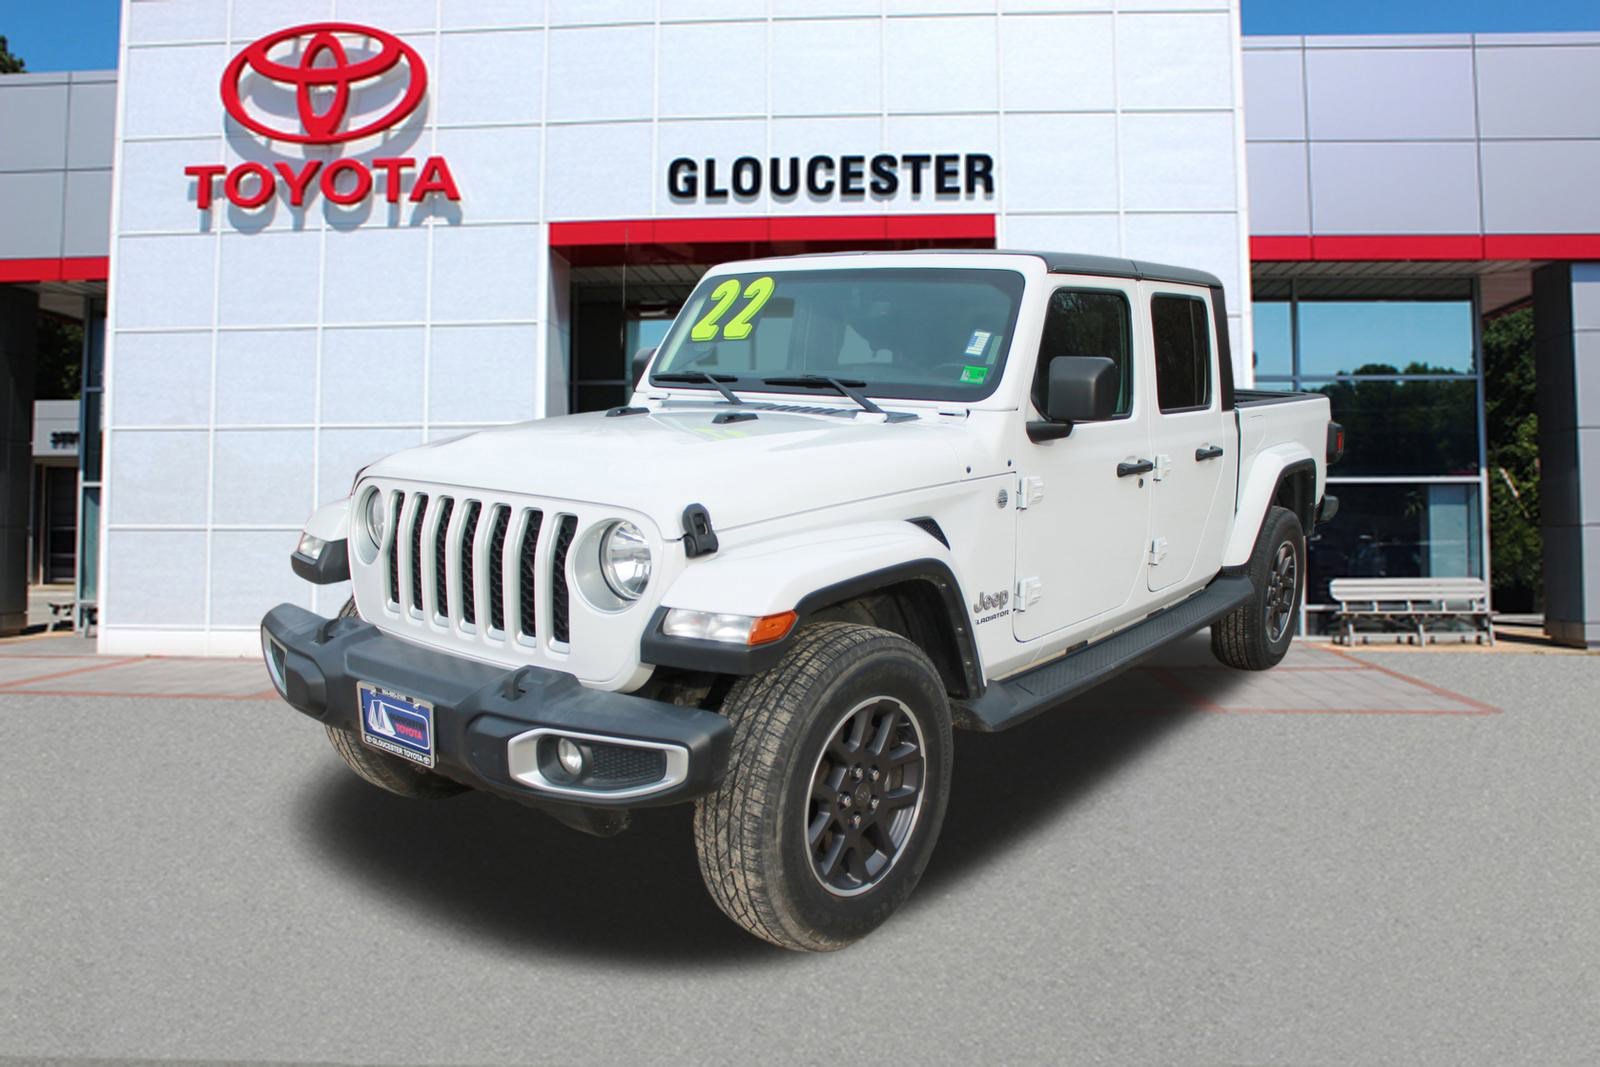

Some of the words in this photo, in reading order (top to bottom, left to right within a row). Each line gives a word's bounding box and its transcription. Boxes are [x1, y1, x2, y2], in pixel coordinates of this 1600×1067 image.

[184, 156, 461, 209] TOYOTA
[668, 153, 995, 199] GLOUCESTER
[691, 276, 775, 342] 22
[973, 590, 1009, 613] Jeep
[395, 722, 423, 740] TOYOTA
[373, 737, 403, 755] GLOUCESTER
[403, 748, 424, 762] TOYOTA
